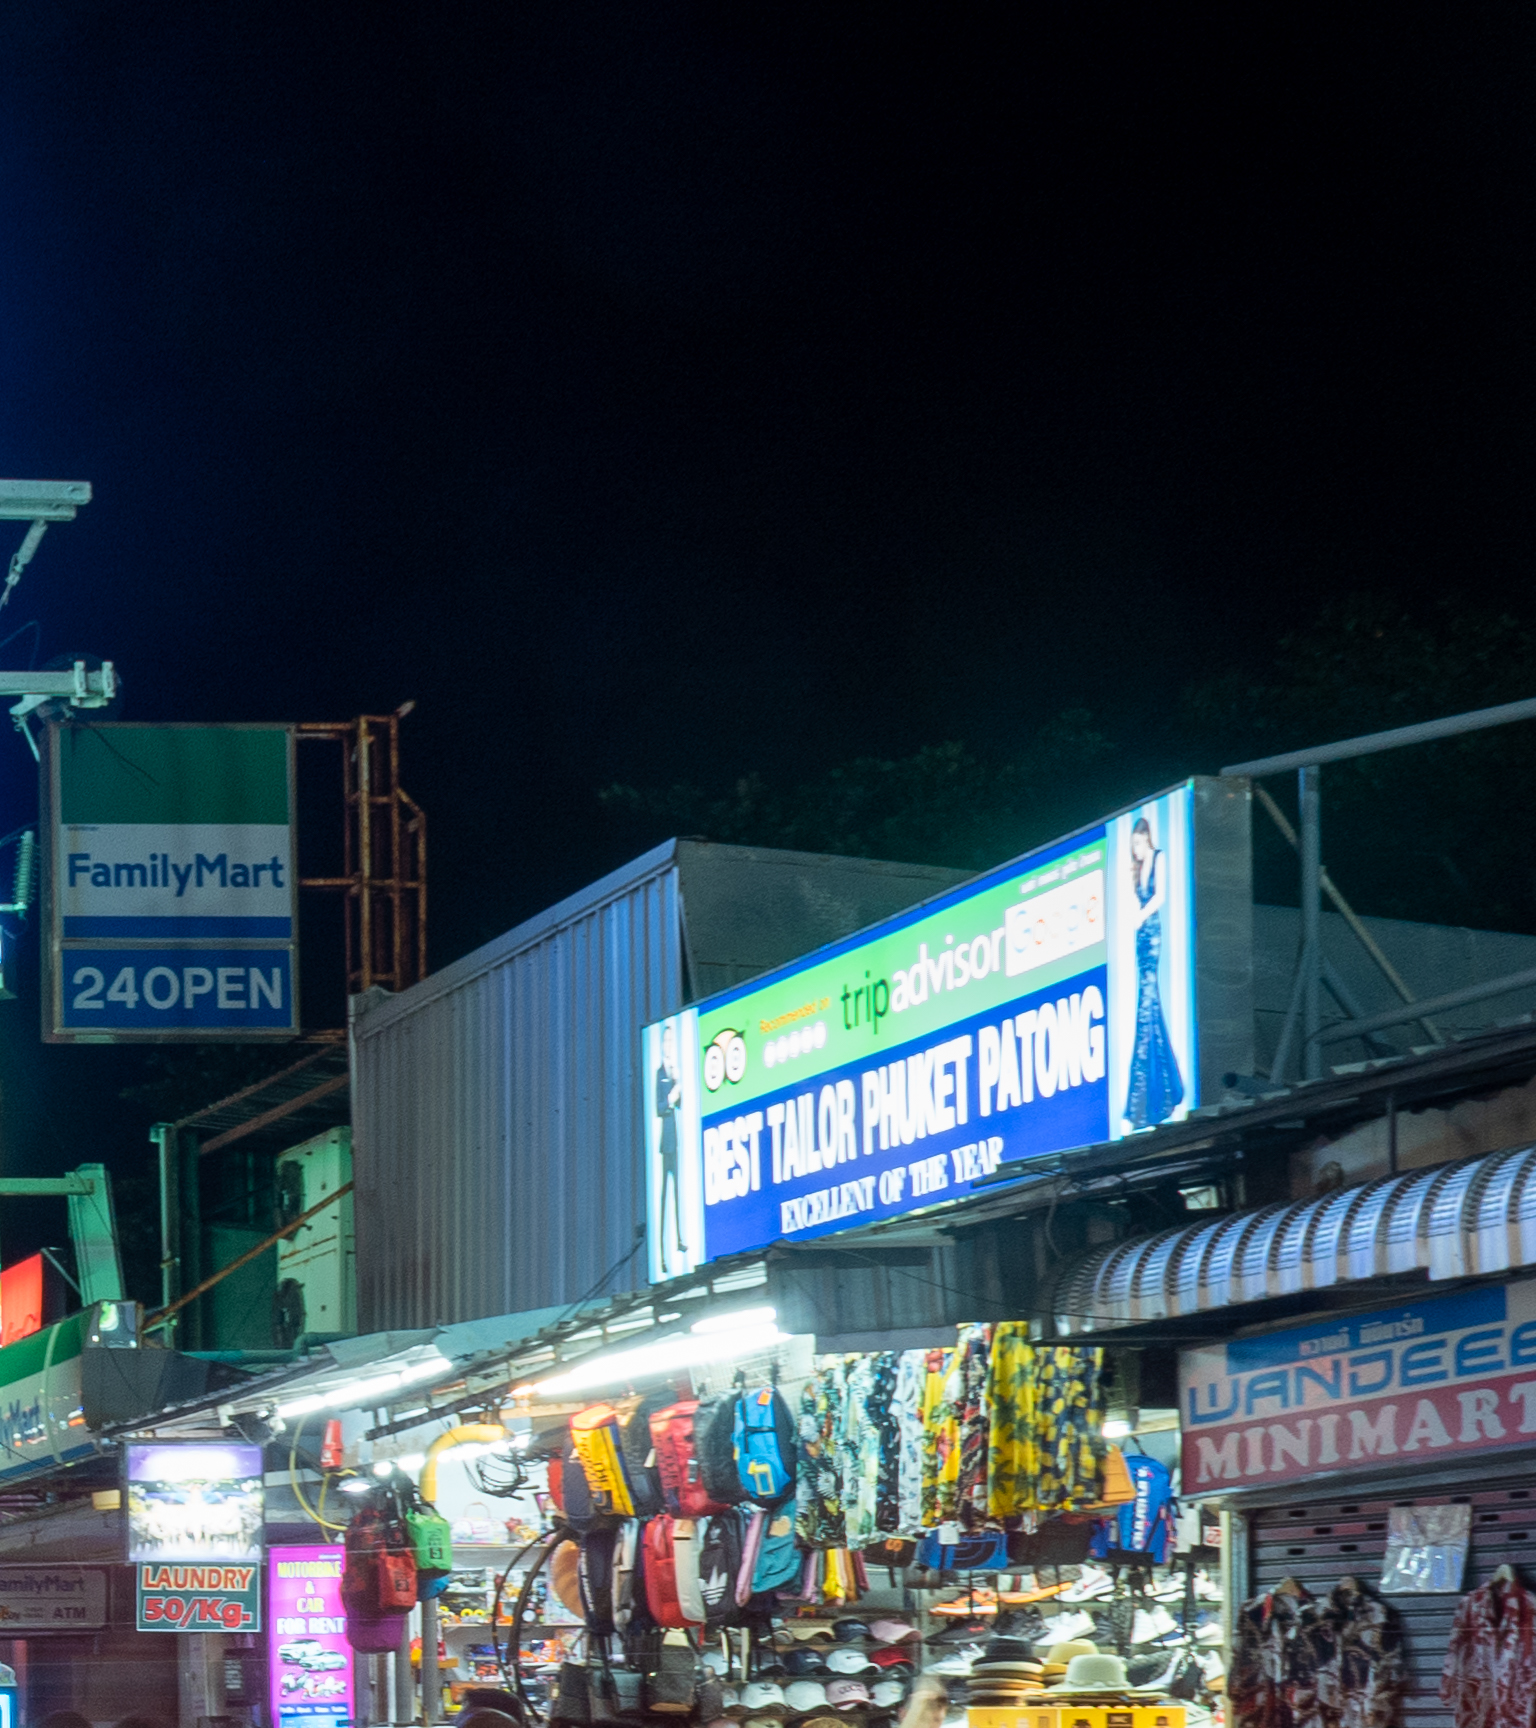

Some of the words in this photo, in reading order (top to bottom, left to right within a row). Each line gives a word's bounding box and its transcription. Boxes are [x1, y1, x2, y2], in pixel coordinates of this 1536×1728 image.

[66, 853, 285, 897] FamilyMart
[703, 1111, 764, 1206] BEST
[767, 1079, 857, 1184] TAILOR
[861, 1034, 973, 1155] PHUKET
[978, 985, 1106, 1117] PATONG
[780, 1175, 876, 1235] EXCELLENT
[879, 1166, 907, 1204] OF
[909, 1153, 948, 1196] THE
[951, 1136, 1004, 1184] YEAR
[142, 1567, 254, 1591] LAUNDRY
[52, 1607, 86, 1619] ATM
[143, 1596, 252, 1630] 50/Kg.
[297, 1598, 324, 1613] CAR
[277, 1617, 306, 1635] FOR
[309, 1617, 345, 1634] RENT
